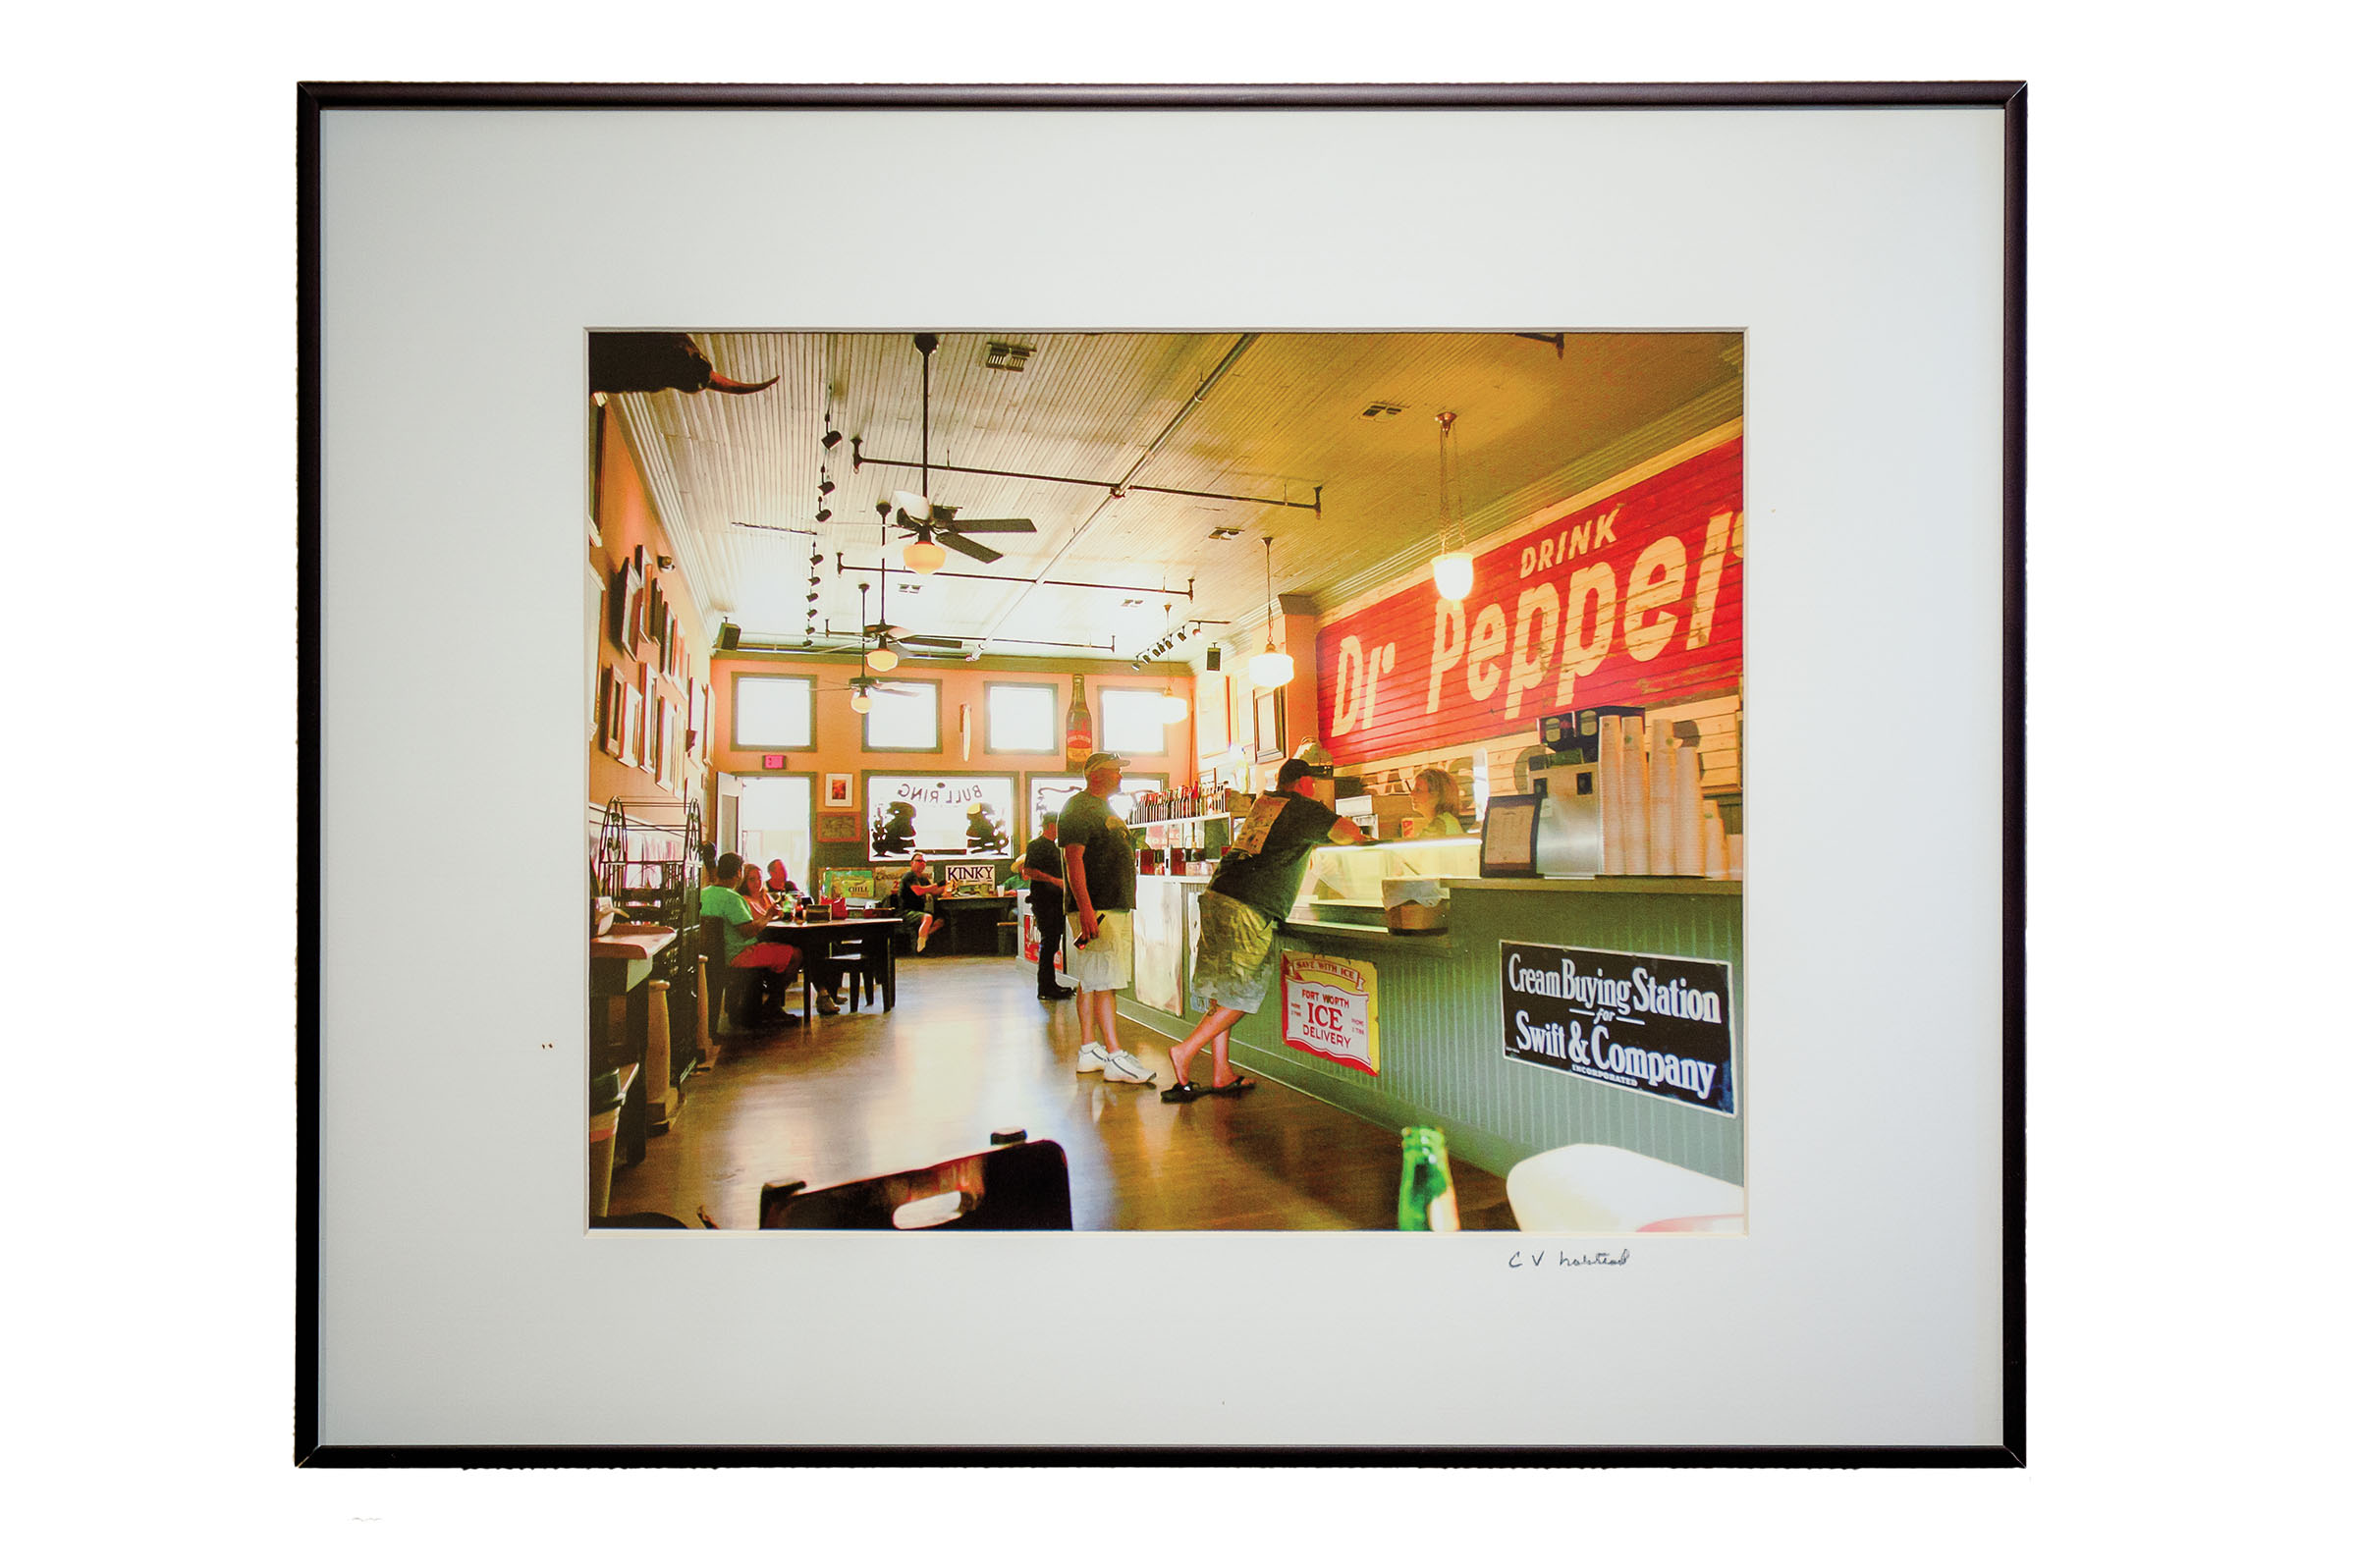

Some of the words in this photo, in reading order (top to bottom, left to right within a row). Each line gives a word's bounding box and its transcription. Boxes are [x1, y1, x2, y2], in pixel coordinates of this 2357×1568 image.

[1519, 506, 1620, 578] DRINK
[1331, 634, 1396, 737] Dr
[1426, 510, 1744, 721] Pepper
[948, 867, 994, 882] KINKY
[1296, 960, 1314, 969] SAVE
[1318, 962, 1338, 973] WITH
[1341, 967, 1354, 979] ICE
[1302, 989, 1319, 1001] FORT
[1323, 994, 1349, 1008] WORTH
[1508, 953, 1561, 998] Cream
[1562, 957, 1631, 1015] Buying
[1632, 966, 1722, 1024] Station
[1307, 1002, 1343, 1032] ICE
[1593, 1008, 1616, 1024] for
[1303, 1024, 1351, 1049] DELIVERY
[1515, 1009, 1566, 1059] Swift
[1568, 1020, 1591, 1065] &
[1591, 1025, 1717, 1100] Company
[1572, 1063, 1638, 1087] INCORPORATED
[1508, 1251, 1523, 1268] C
[1531, 1250, 1545, 1267] V
